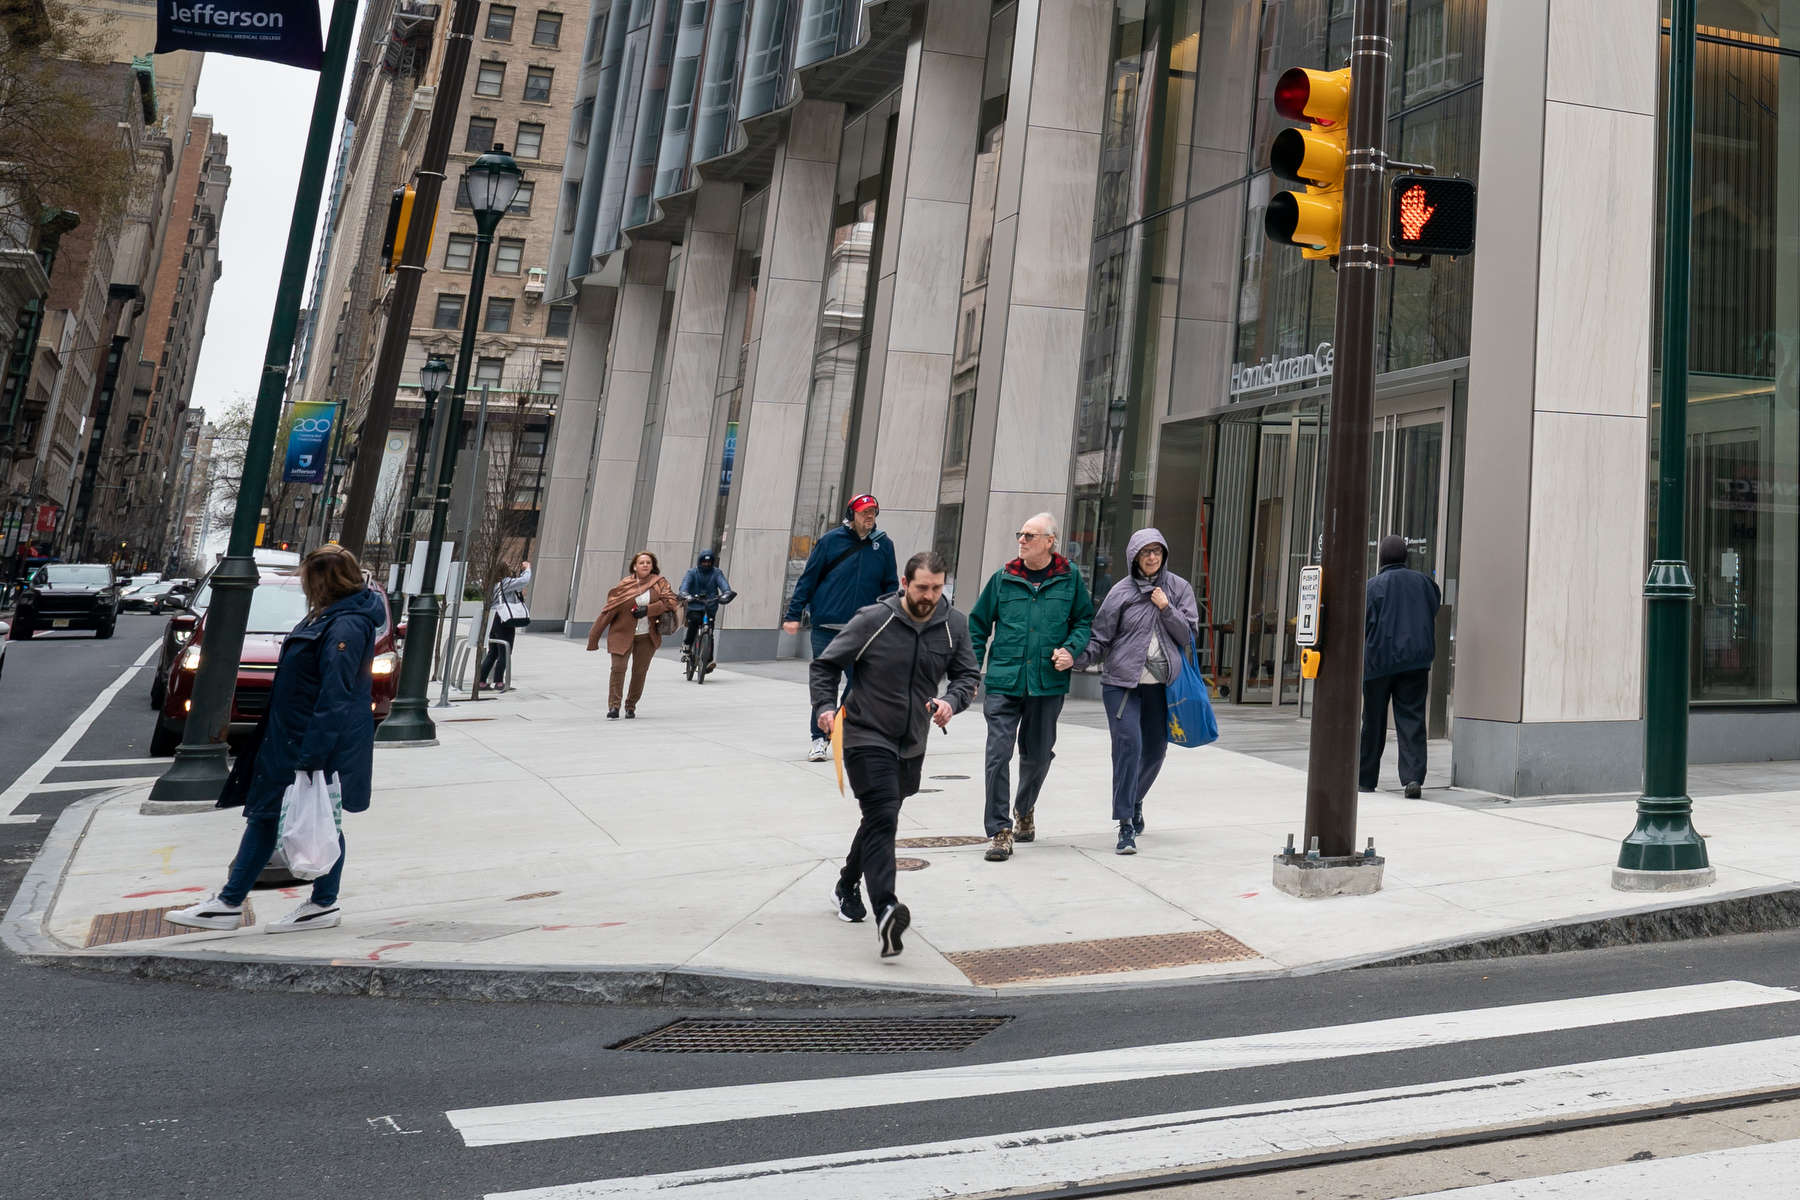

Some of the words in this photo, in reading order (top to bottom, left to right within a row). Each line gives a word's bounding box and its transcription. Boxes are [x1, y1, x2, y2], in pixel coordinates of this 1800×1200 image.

[170, 1, 283, 28] Jefferson
[1231, 354, 1314, 394] Honickman
[293, 418, 331, 432] 200
